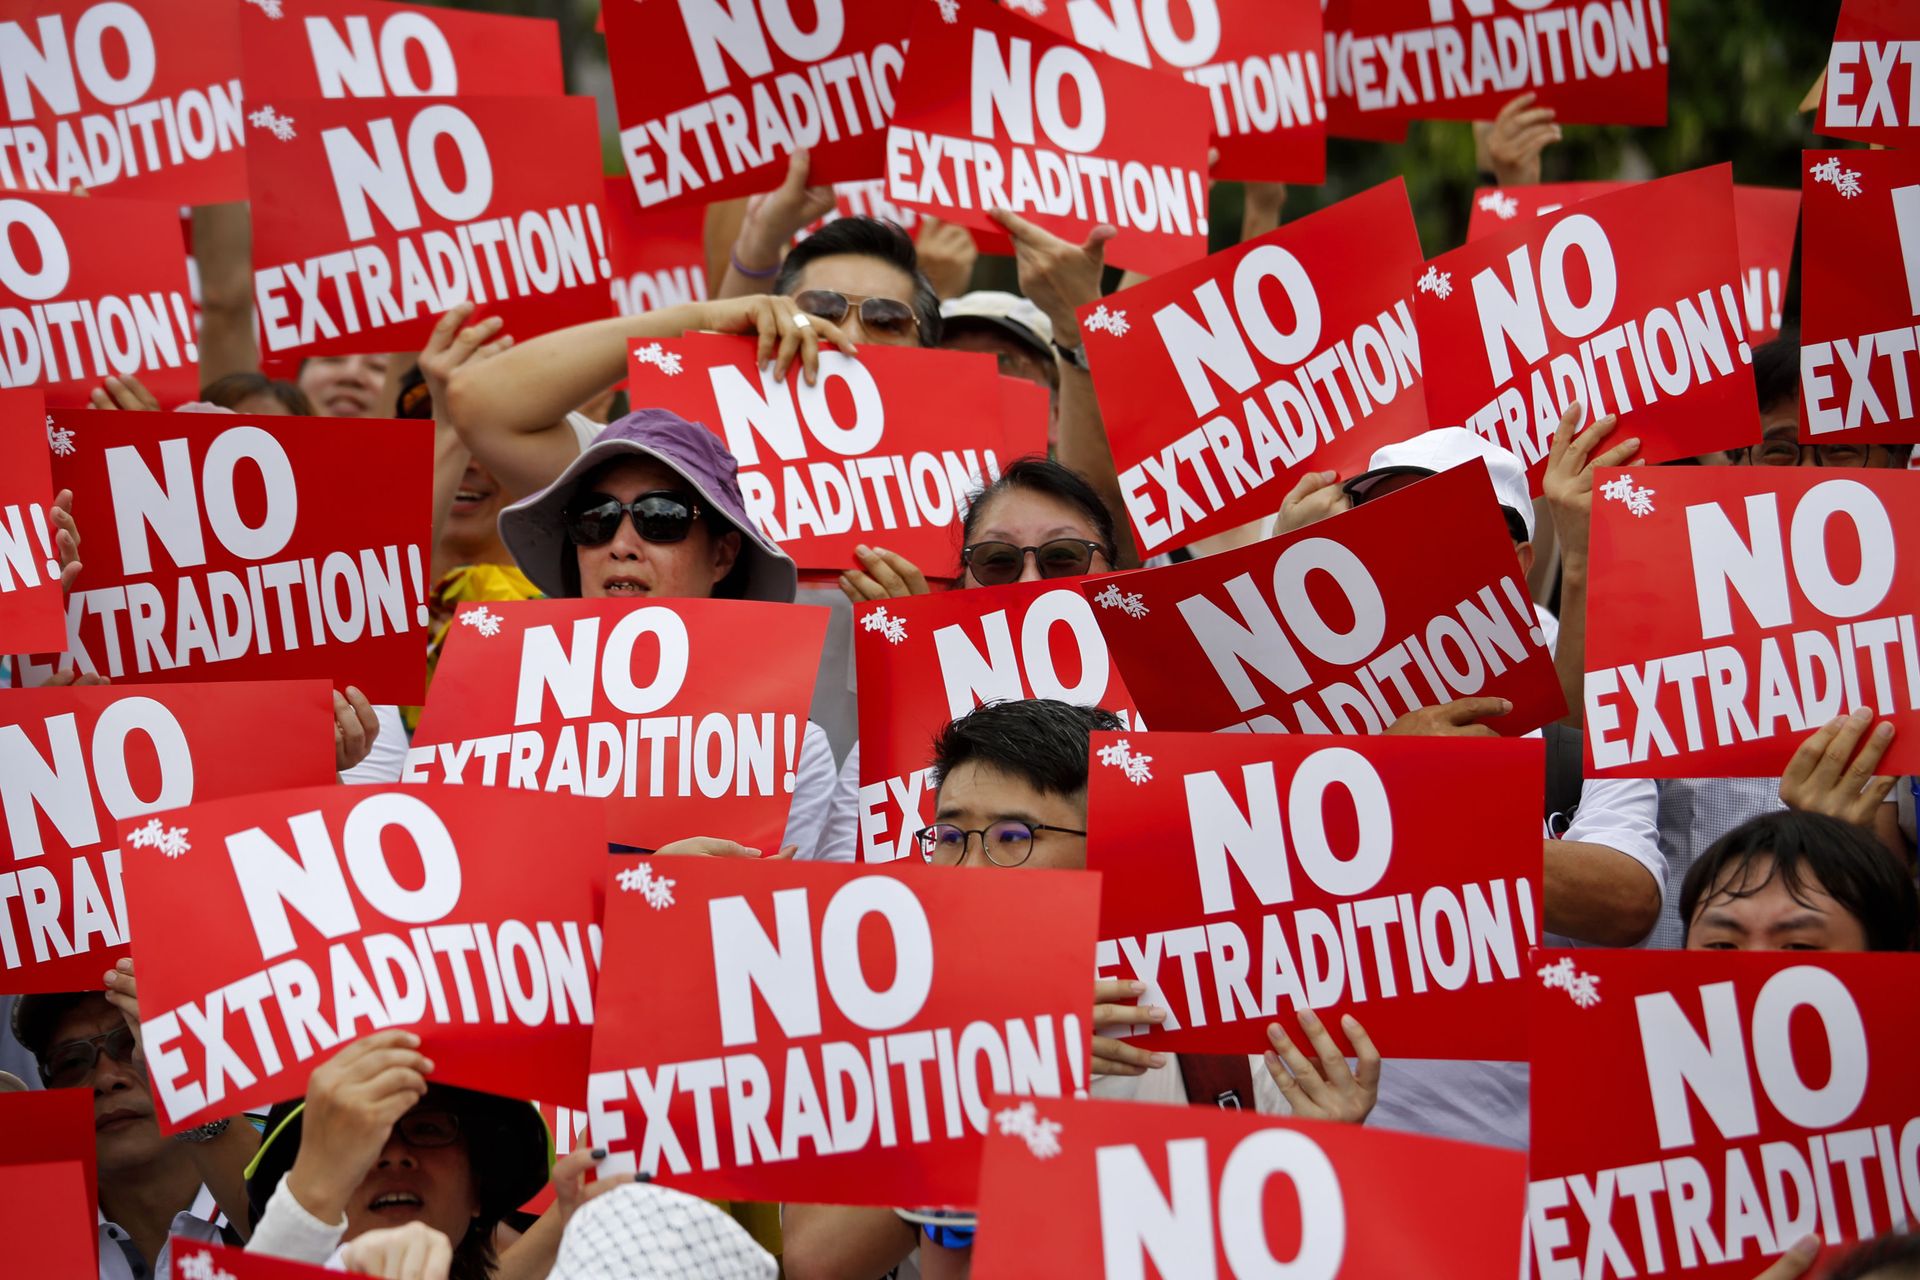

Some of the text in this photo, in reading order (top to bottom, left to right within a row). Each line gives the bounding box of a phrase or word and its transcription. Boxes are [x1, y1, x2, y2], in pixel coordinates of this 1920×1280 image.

[0, 1, 156, 121] NO
[304, 11, 458, 98] NO
[620, 38, 909, 208] EXTRADITIO
[971, 27, 1106, 153] NO
[1183, 51, 1327, 137] TION!
[1353, 0, 1669, 111] EXTRADITION!
[320, 104, 494, 242] NO
[886, 125, 1209, 237] EXTRADITION!
[0, 291, 199, 389] DITION!
[254, 203, 612, 352] EXTRADITION!
[1152, 244, 1321, 419] NO
[1471, 214, 1617, 389] NO
[707, 351, 885, 467] NO
[1117, 294, 1423, 551] EXTRADITION
[1465, 284, 1753, 472] TRADITION!
[1800, 325, 1920, 436] EXT
[105, 426, 298, 576] NO
[1599, 474, 1656, 518] 城寨
[1685, 479, 1896, 639] NO
[18, 544, 430, 687] XTRADITION!
[514, 606, 689, 726] NO
[860, 606, 908, 645] 城寨
[933, 589, 1110, 730] NO
[1094, 584, 1150, 620] 城寨
[1175, 537, 1386, 712] NO
[0, 696, 194, 861] NO
[1097, 739, 1153, 785] 城寨
[1184, 747, 1393, 914] NO
[224, 793, 462, 961] NO
[709, 875, 934, 1048] NO
[1635, 965, 1869, 1150] NO
[1095, 1127, 1346, 1280] NO
